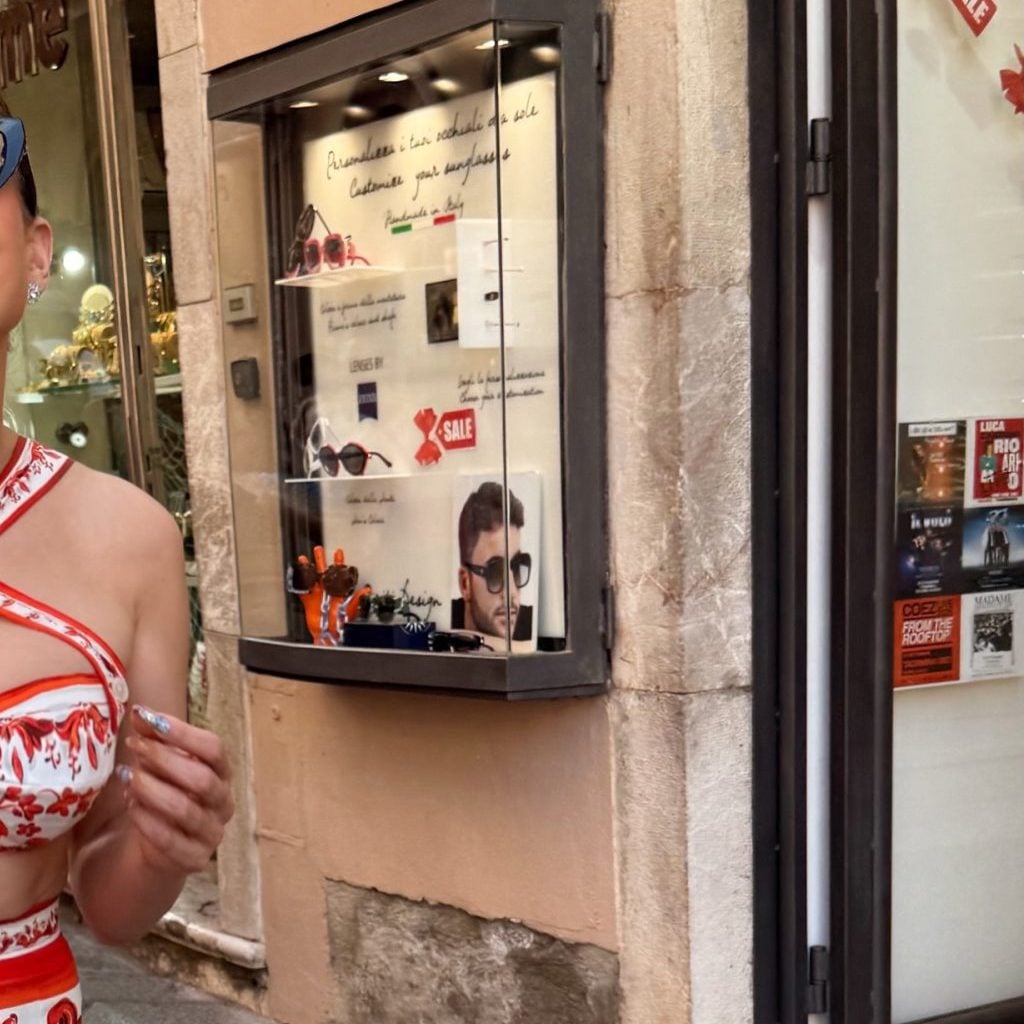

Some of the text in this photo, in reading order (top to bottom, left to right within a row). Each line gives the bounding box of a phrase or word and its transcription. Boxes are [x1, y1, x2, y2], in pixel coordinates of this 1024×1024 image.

[412, 165, 440, 201] your
[444, 142, 511, 185] sunglasss
[443, 417, 473, 442] SALE
[980, 420, 1005, 432] LUCA
[993, 437, 1020, 454] RIO
[902, 601, 936, 617] COEZ
[902, 616, 954, 634] FROM THE
[901, 629, 951, 646] ROOFTOP
